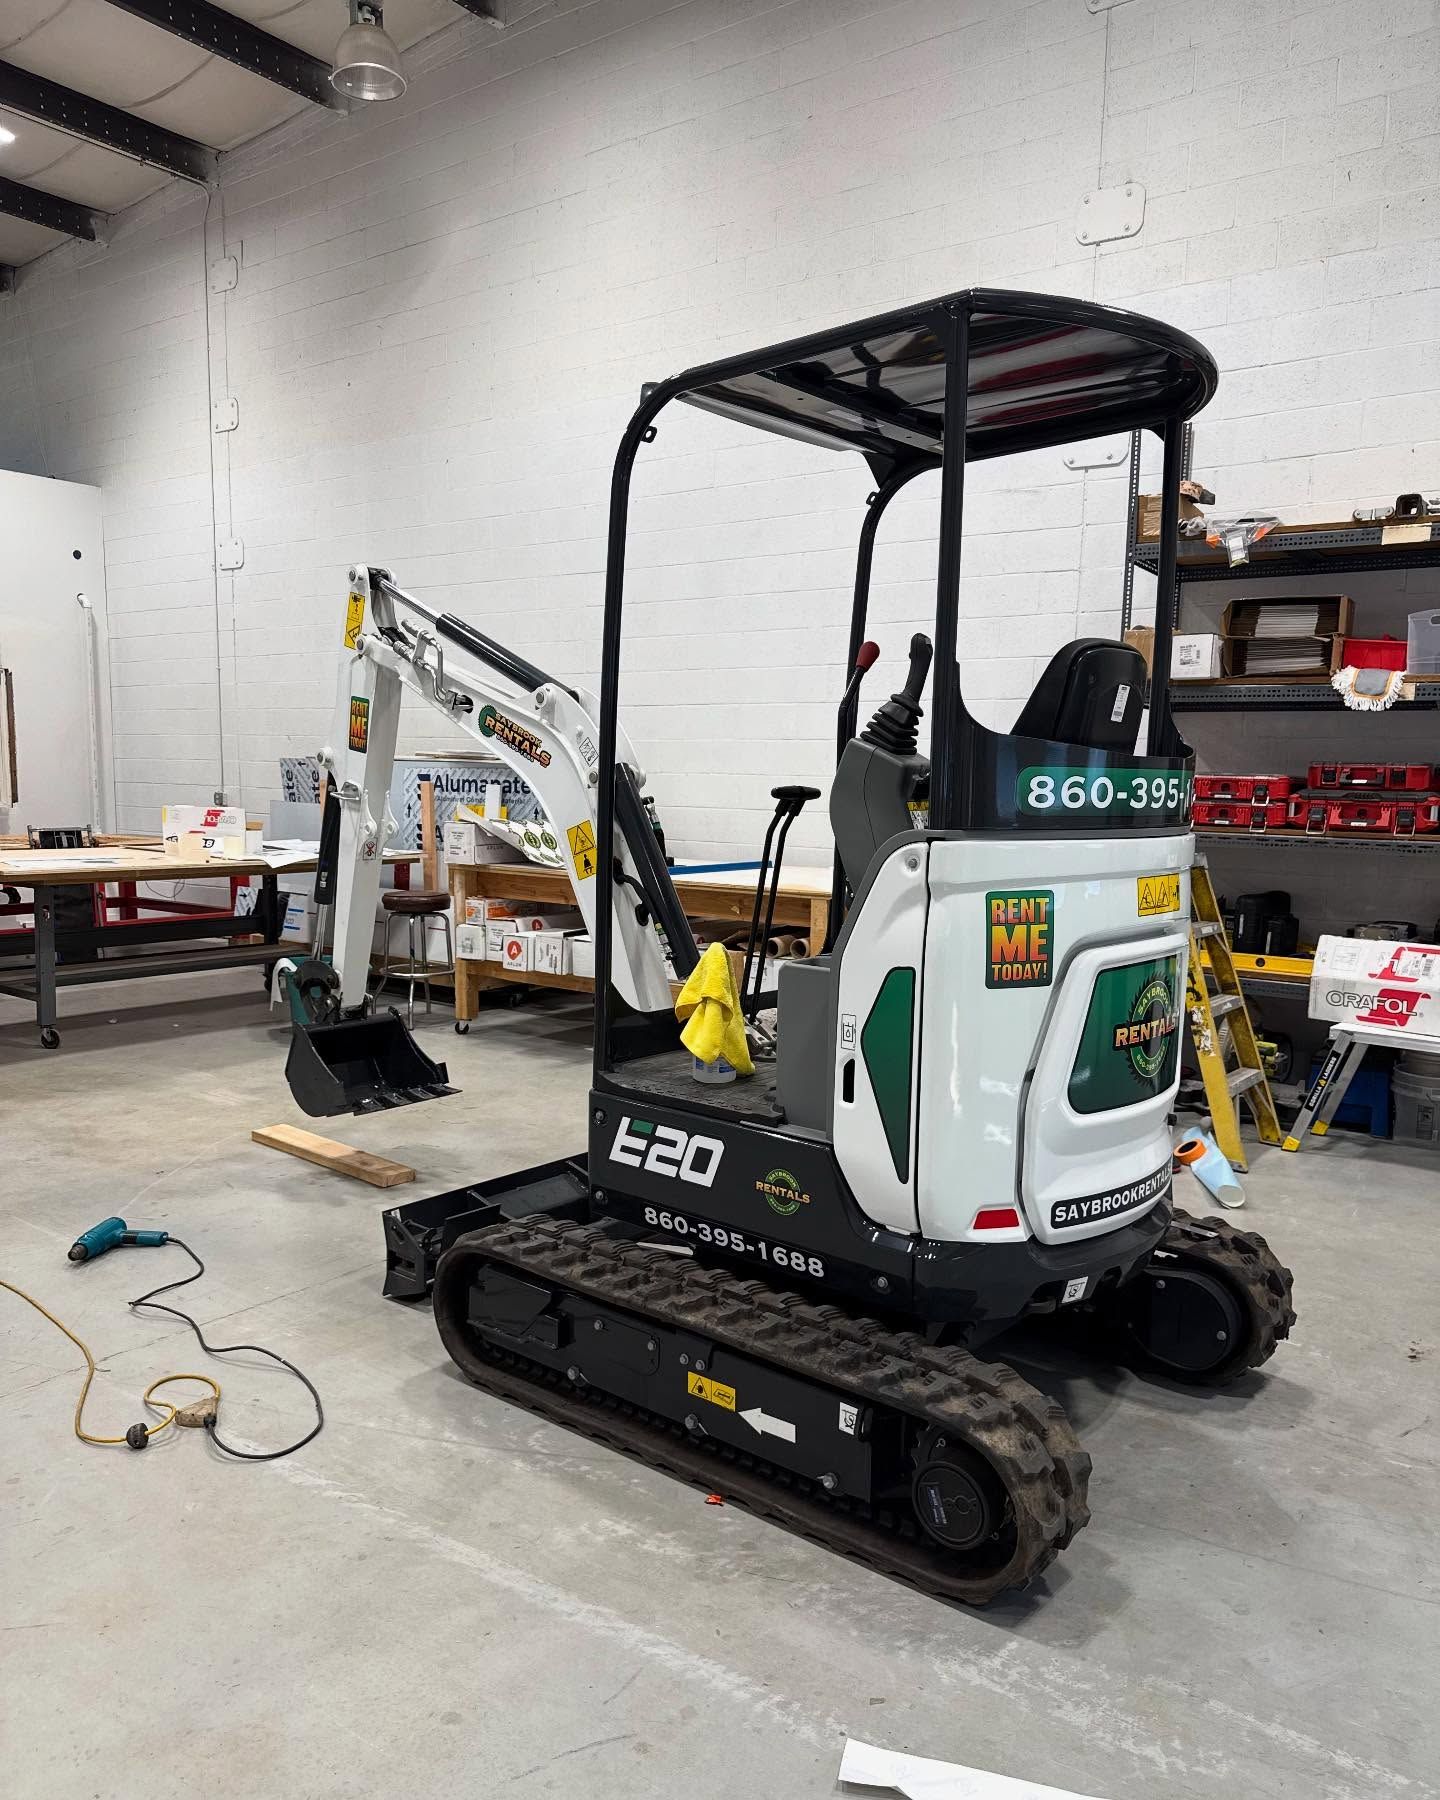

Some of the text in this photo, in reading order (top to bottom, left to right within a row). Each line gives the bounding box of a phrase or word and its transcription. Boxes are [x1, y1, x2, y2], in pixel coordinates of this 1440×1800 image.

[351, 714, 367, 739] ME
[484, 715, 552, 766] RENTALS
[495, 712, 542, 747] SAYBROOK
[991, 897, 1050, 924] RENT
[991, 923, 1048, 963] ME
[991, 962, 1048, 982] TODAY!
[1137, 986, 1169, 1016] SAYBROOK
[1326, 990, 1417, 1017] ORAFOL
[1115, 1013, 1177, 1048] RENTALS
[608, 1116, 725, 1188] E20
[755, 1180, 811, 1205] RENTALS
[643, 1206, 826, 1278] 860-395-1688
